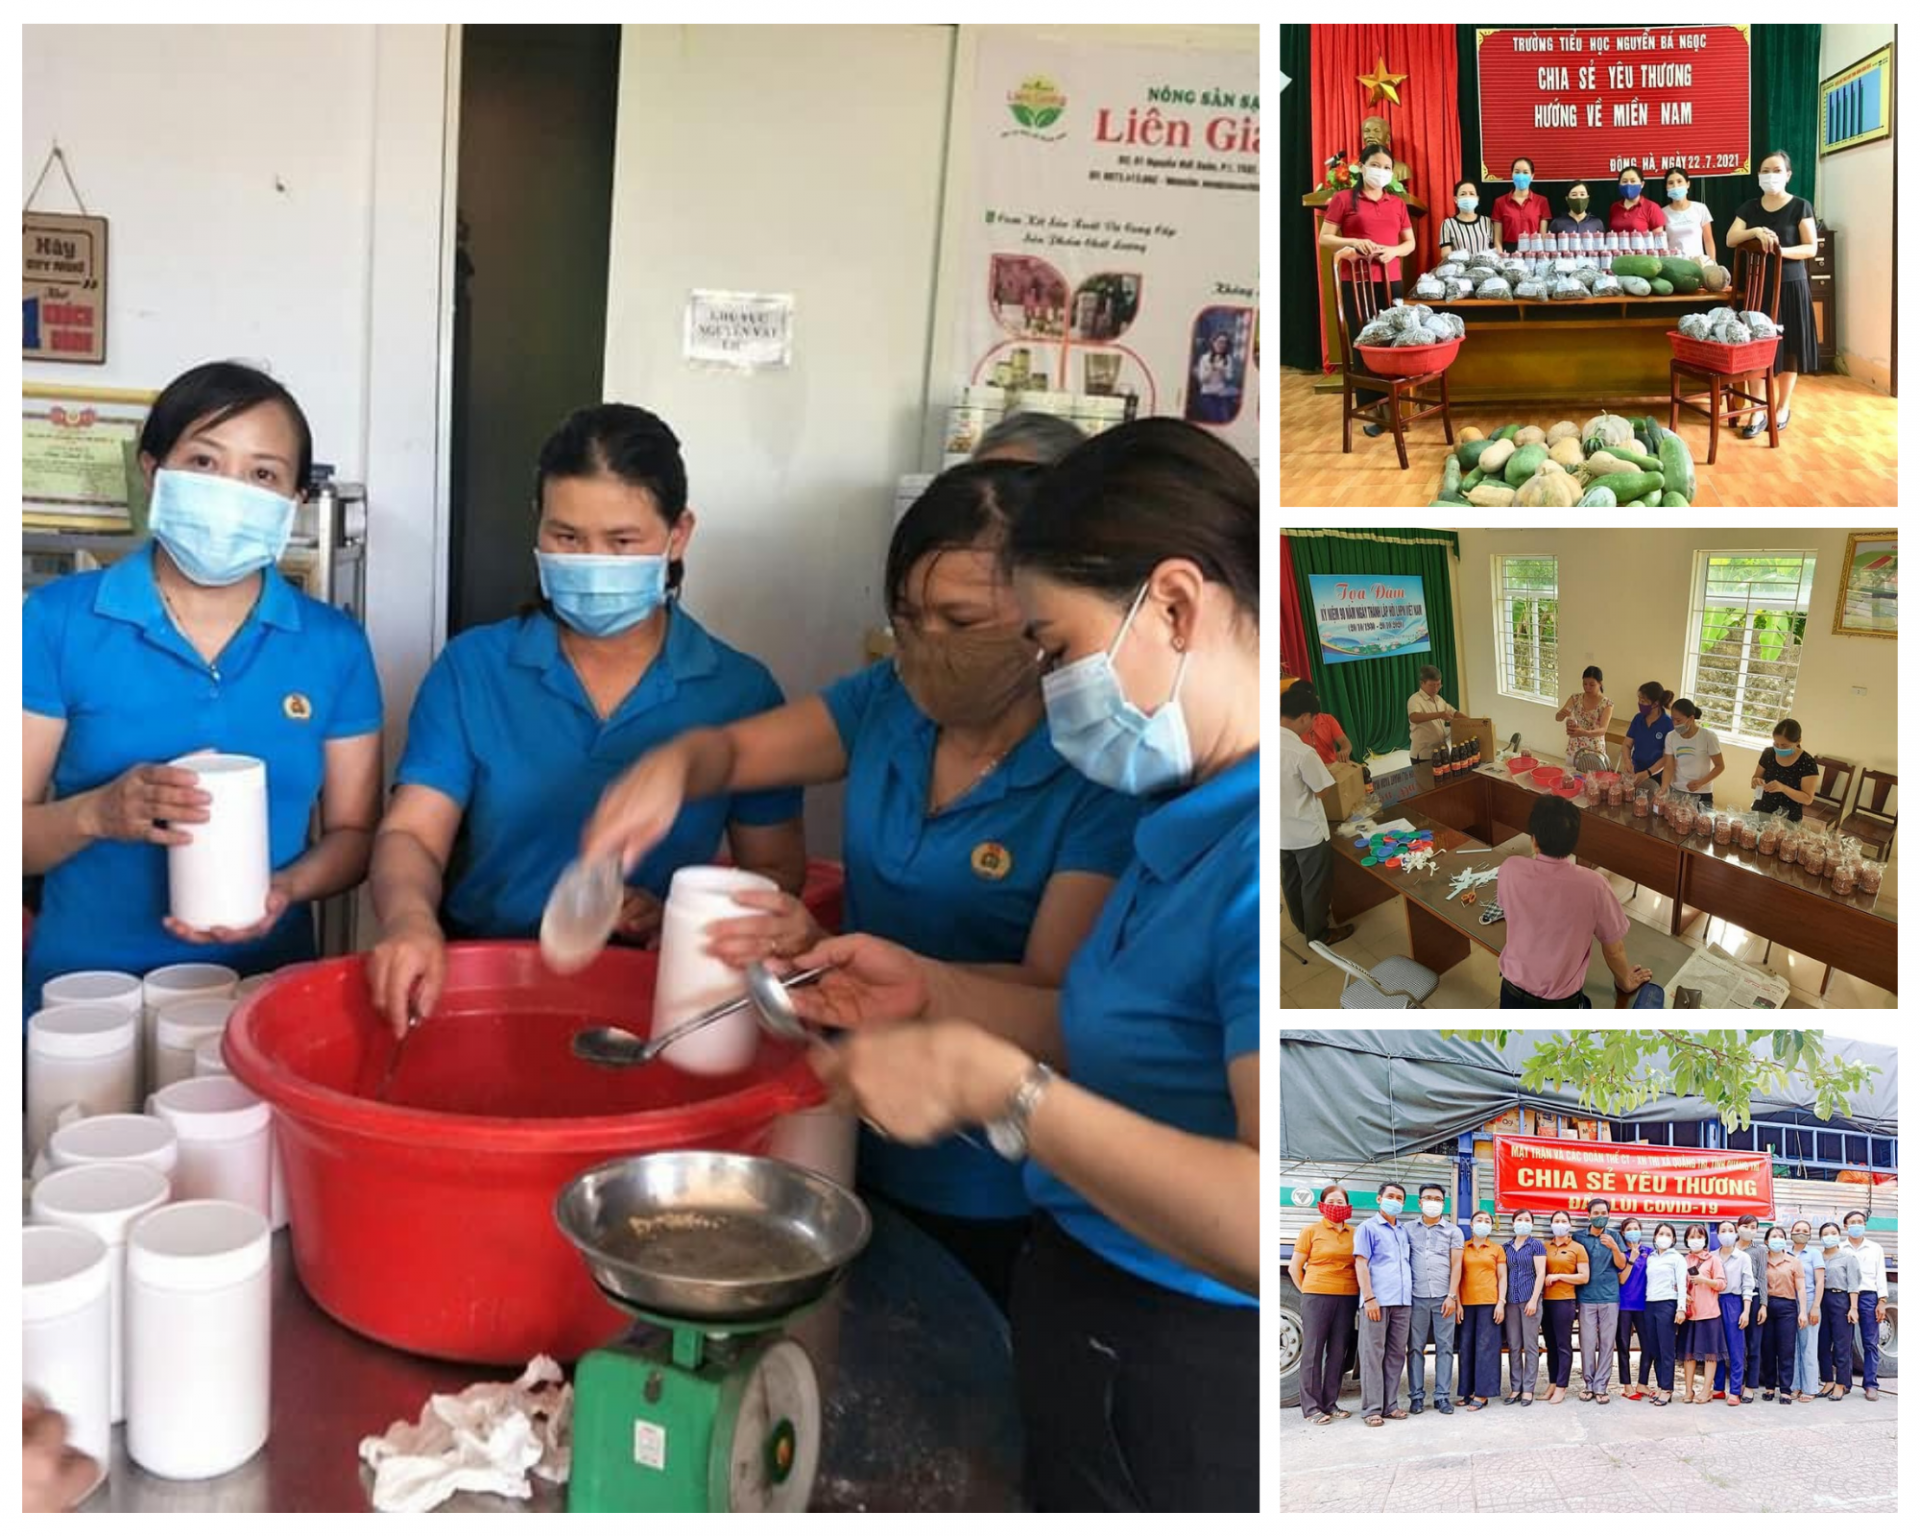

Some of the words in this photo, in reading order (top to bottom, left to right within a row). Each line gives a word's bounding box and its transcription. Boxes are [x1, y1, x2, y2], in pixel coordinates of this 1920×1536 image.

[1513, 32, 1553, 51] TRƯỜNG
[1559, 29, 1582, 51] TIỂU
[1589, 36, 1610, 55] HỌC
[1616, 28, 1655, 50] NGUYỄN
[1660, 31, 1674, 49] BÁ
[1679, 33, 1707, 52] NGỌC
[1538, 66, 1570, 90] CHIA
[1578, 59, 1596, 90] SẺ
[1608, 61, 1634, 89] YÊU
[1640, 62, 1692, 88] THƯƠNG
[1148, 85, 1196, 104] NÔNG
[1534, 97, 1577, 128] HƯỚNG
[1586, 97, 1603, 127] VỀ
[1613, 96, 1648, 127] MIỀN
[1660, 102, 1693, 125] NAM
[1095, 107, 1191, 148] Liên
[1335, 582, 1366, 603] Tọa
[1531, 1146, 1554, 1162] TRẬN
[1554, 1147, 1565, 1160] VÀ
[1567, 1148, 1582, 1161] CÁC
[1583, 1149, 1604, 1163] ĐOÀN
[1621, 1154, 1631, 1165] CT
[1517, 1167, 1578, 1190] CHIA
[1586, 1166, 1616, 1191] SẺ
[1624, 1171, 1667, 1193] YÊU
[1673, 1176, 1758, 1196] THƯƠNG
[1611, 1195, 1638, 1212] LÙI
[1643, 1199, 1719, 1214] COVID-19
